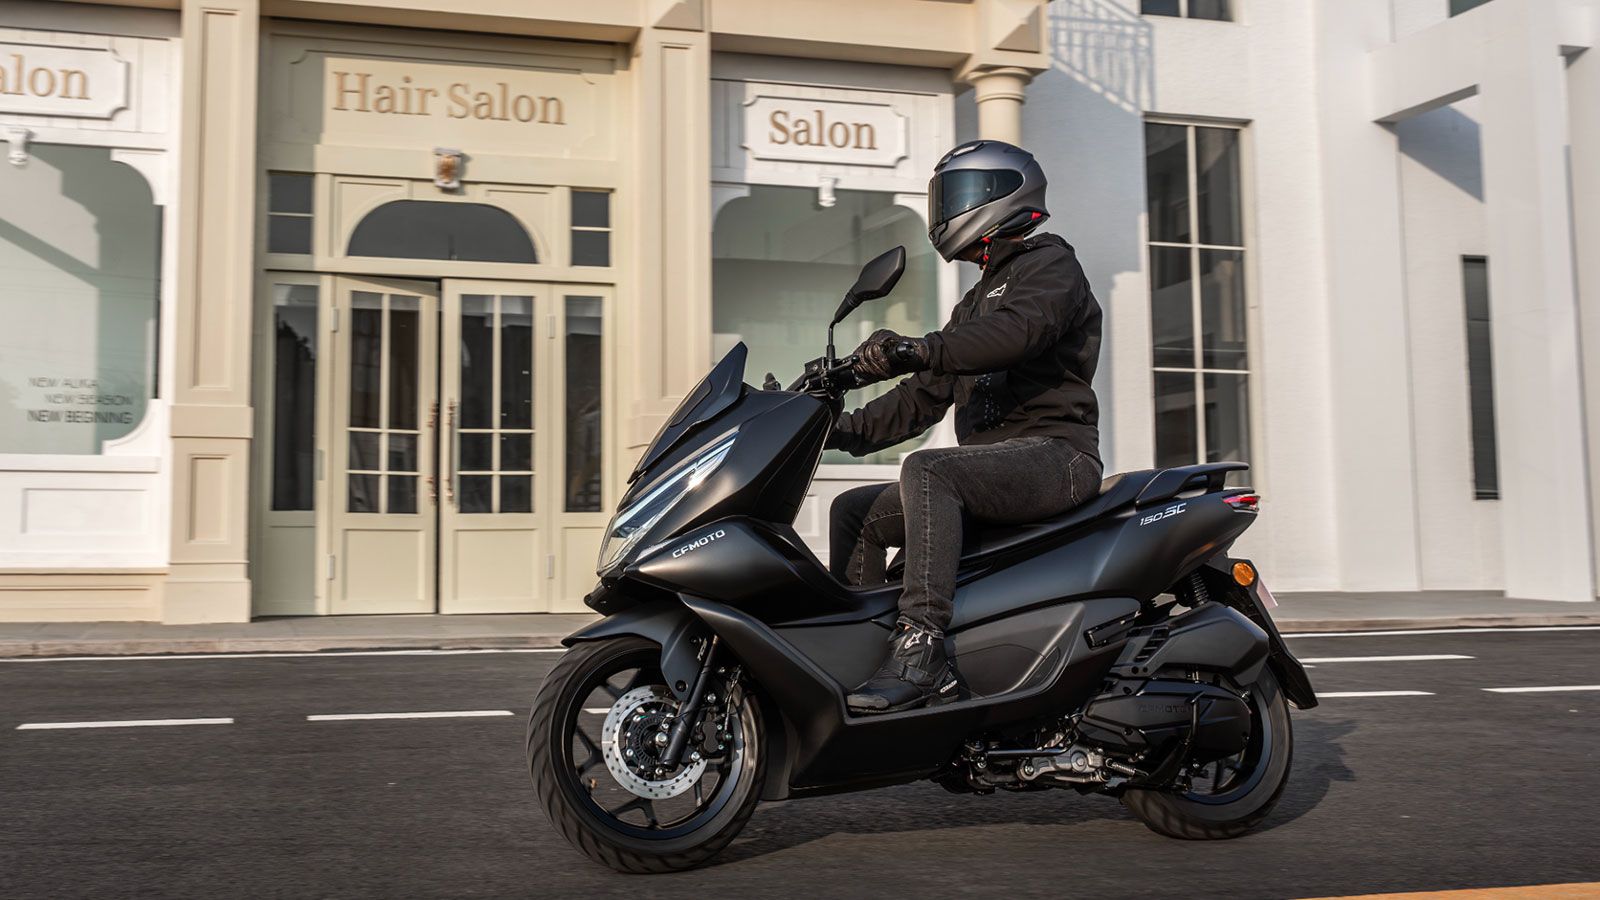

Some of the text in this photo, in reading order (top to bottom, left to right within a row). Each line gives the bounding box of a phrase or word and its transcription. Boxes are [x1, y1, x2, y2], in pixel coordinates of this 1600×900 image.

[332, 70, 567, 126] Hair Salon
[768, 109, 879, 151] Salon
[27, 409, 62, 423] NEW
[672, 529, 726, 559] CFMOTO
